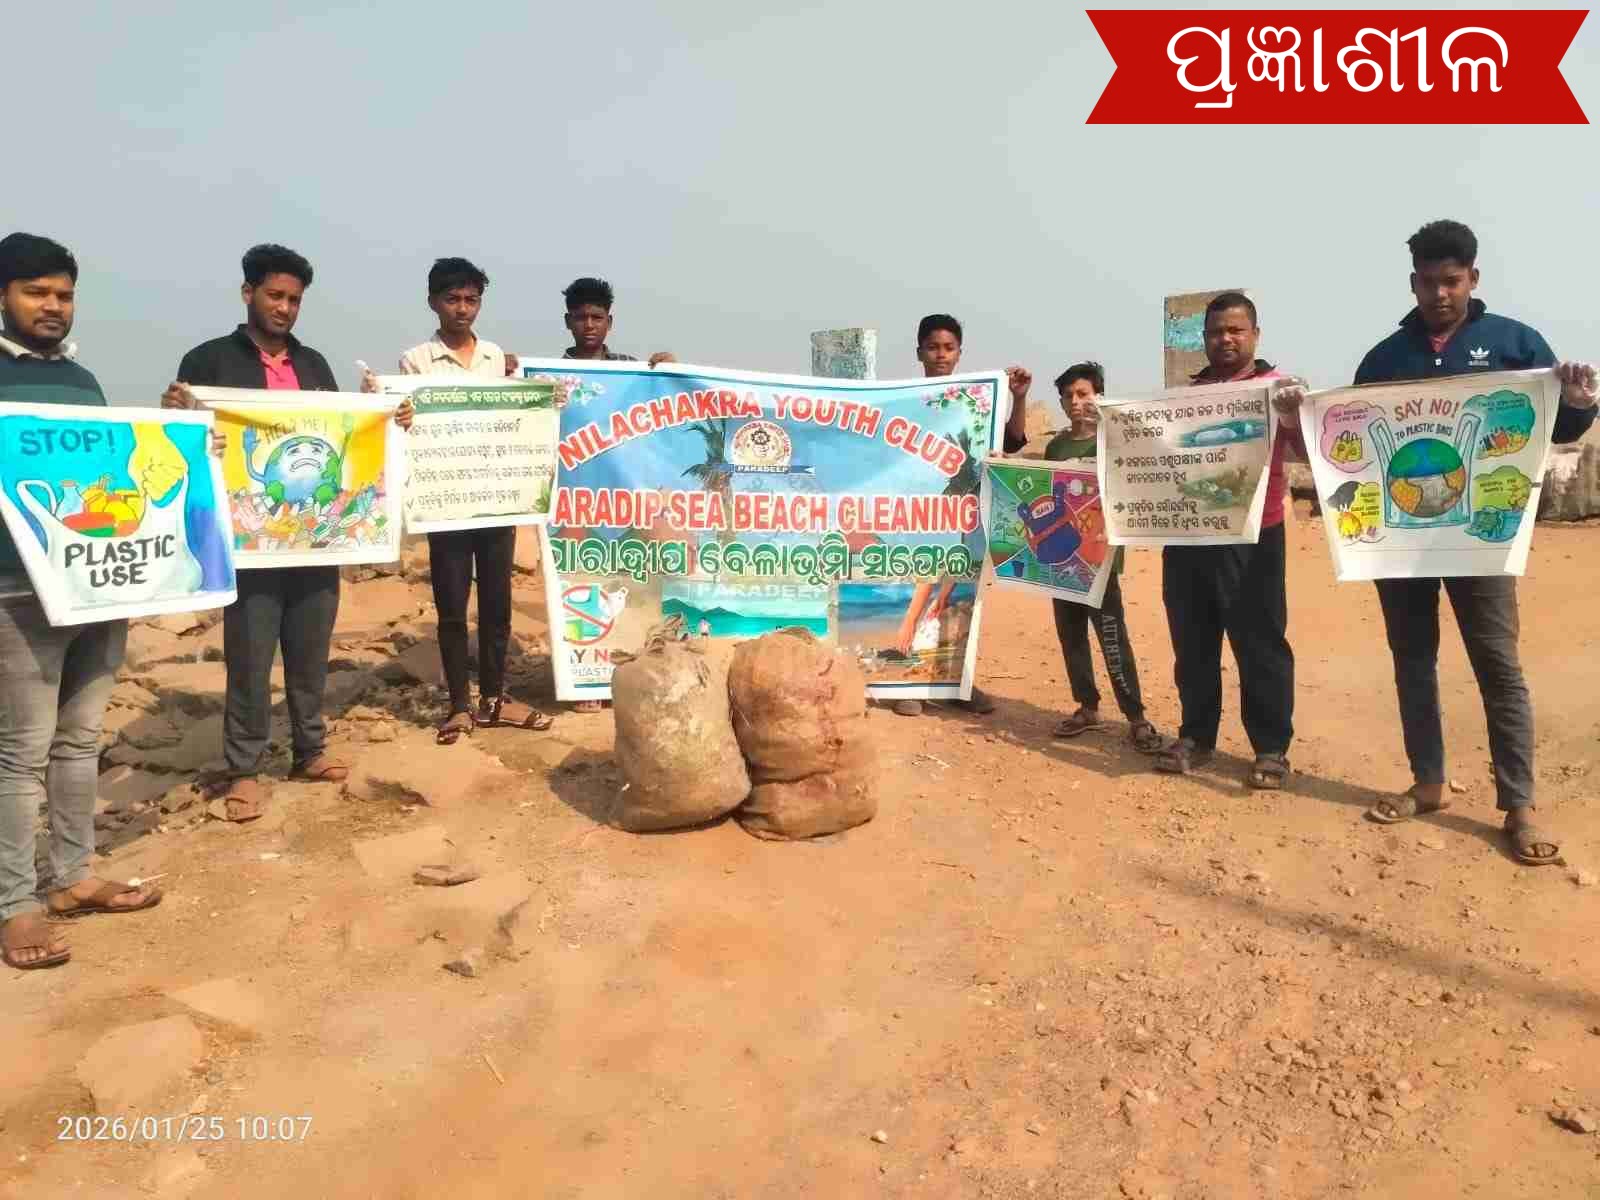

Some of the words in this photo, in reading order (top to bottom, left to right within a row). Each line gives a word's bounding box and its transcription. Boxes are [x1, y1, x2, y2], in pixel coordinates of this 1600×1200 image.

[1395, 398, 1424, 422] SAY
[1429, 398, 1460, 419] NO!
[19, 428, 116, 457] STOP!
[558, 388, 763, 470] NILACHAKRA
[773, 394, 880, 437] YOUTH
[884, 417, 966, 476] CLUB
[554, 488, 660, 527] ARADIP
[669, 491, 725, 529] SEA
[735, 493, 828, 531] BEACH
[837, 495, 979, 533] CLEANING
[64, 534, 176, 569] PLASTIC
[90, 562, 148, 588] USE
